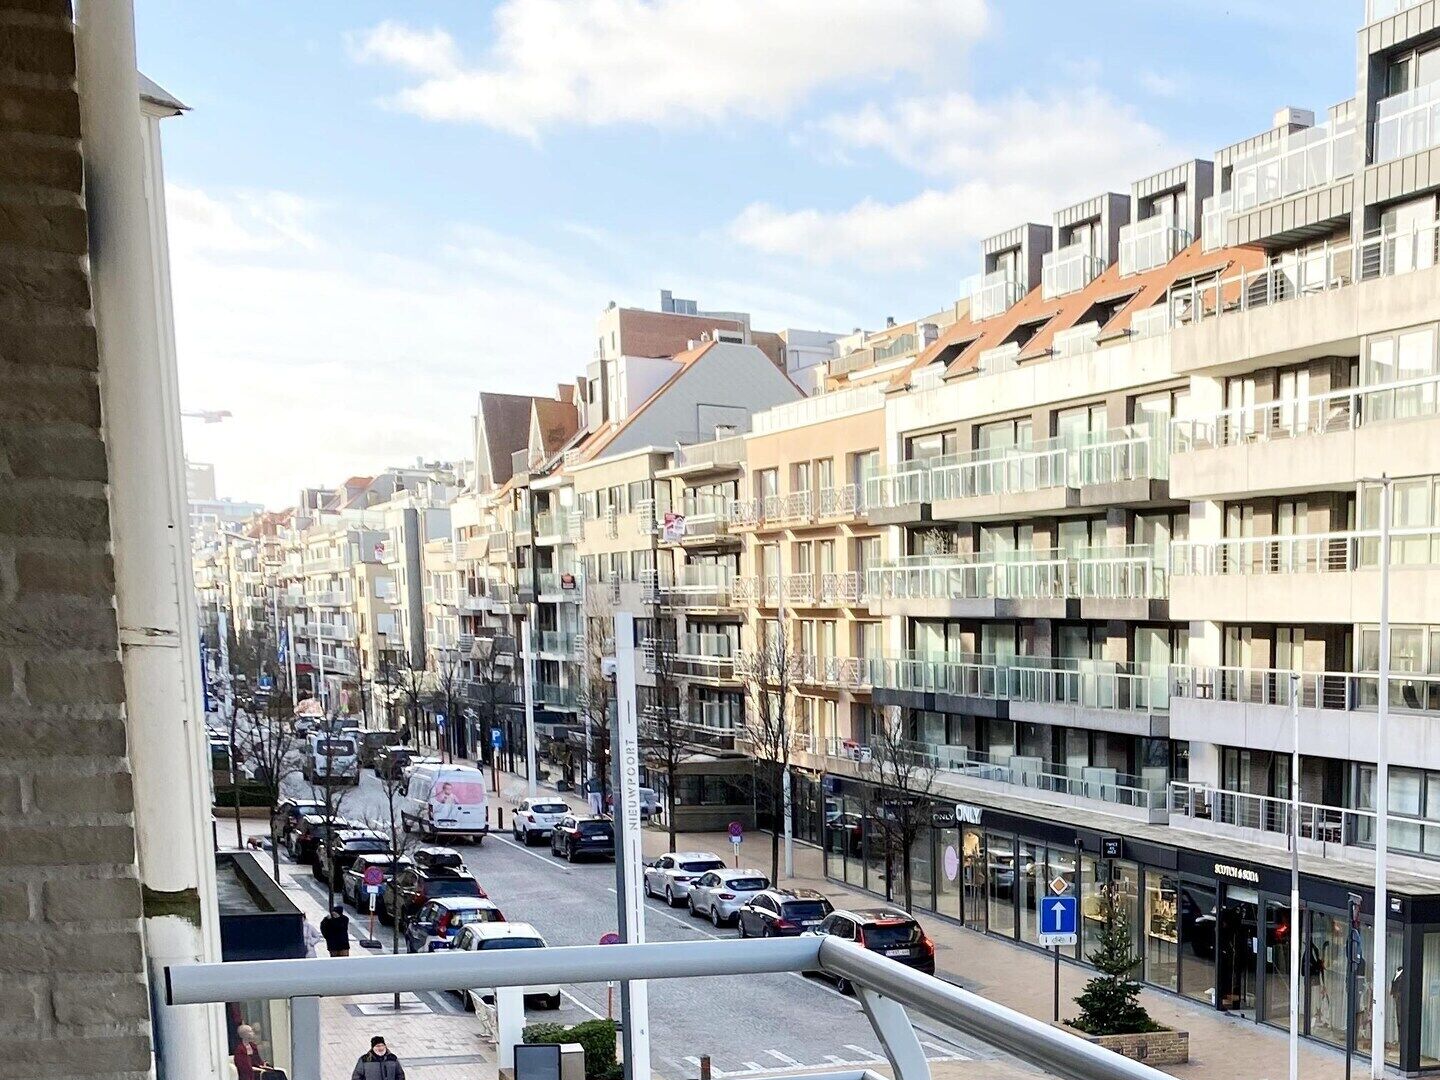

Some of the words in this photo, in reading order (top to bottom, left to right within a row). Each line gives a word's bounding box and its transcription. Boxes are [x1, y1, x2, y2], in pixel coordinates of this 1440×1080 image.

[436, 714, 444, 724] P
[492, 730, 501, 740] P
[626, 738, 639, 831] NIEUWPOORT
[932, 813, 955, 821] ONLY
[956, 803, 983, 825] ONLY
[1214, 863, 1237, 878] SCOTCH
